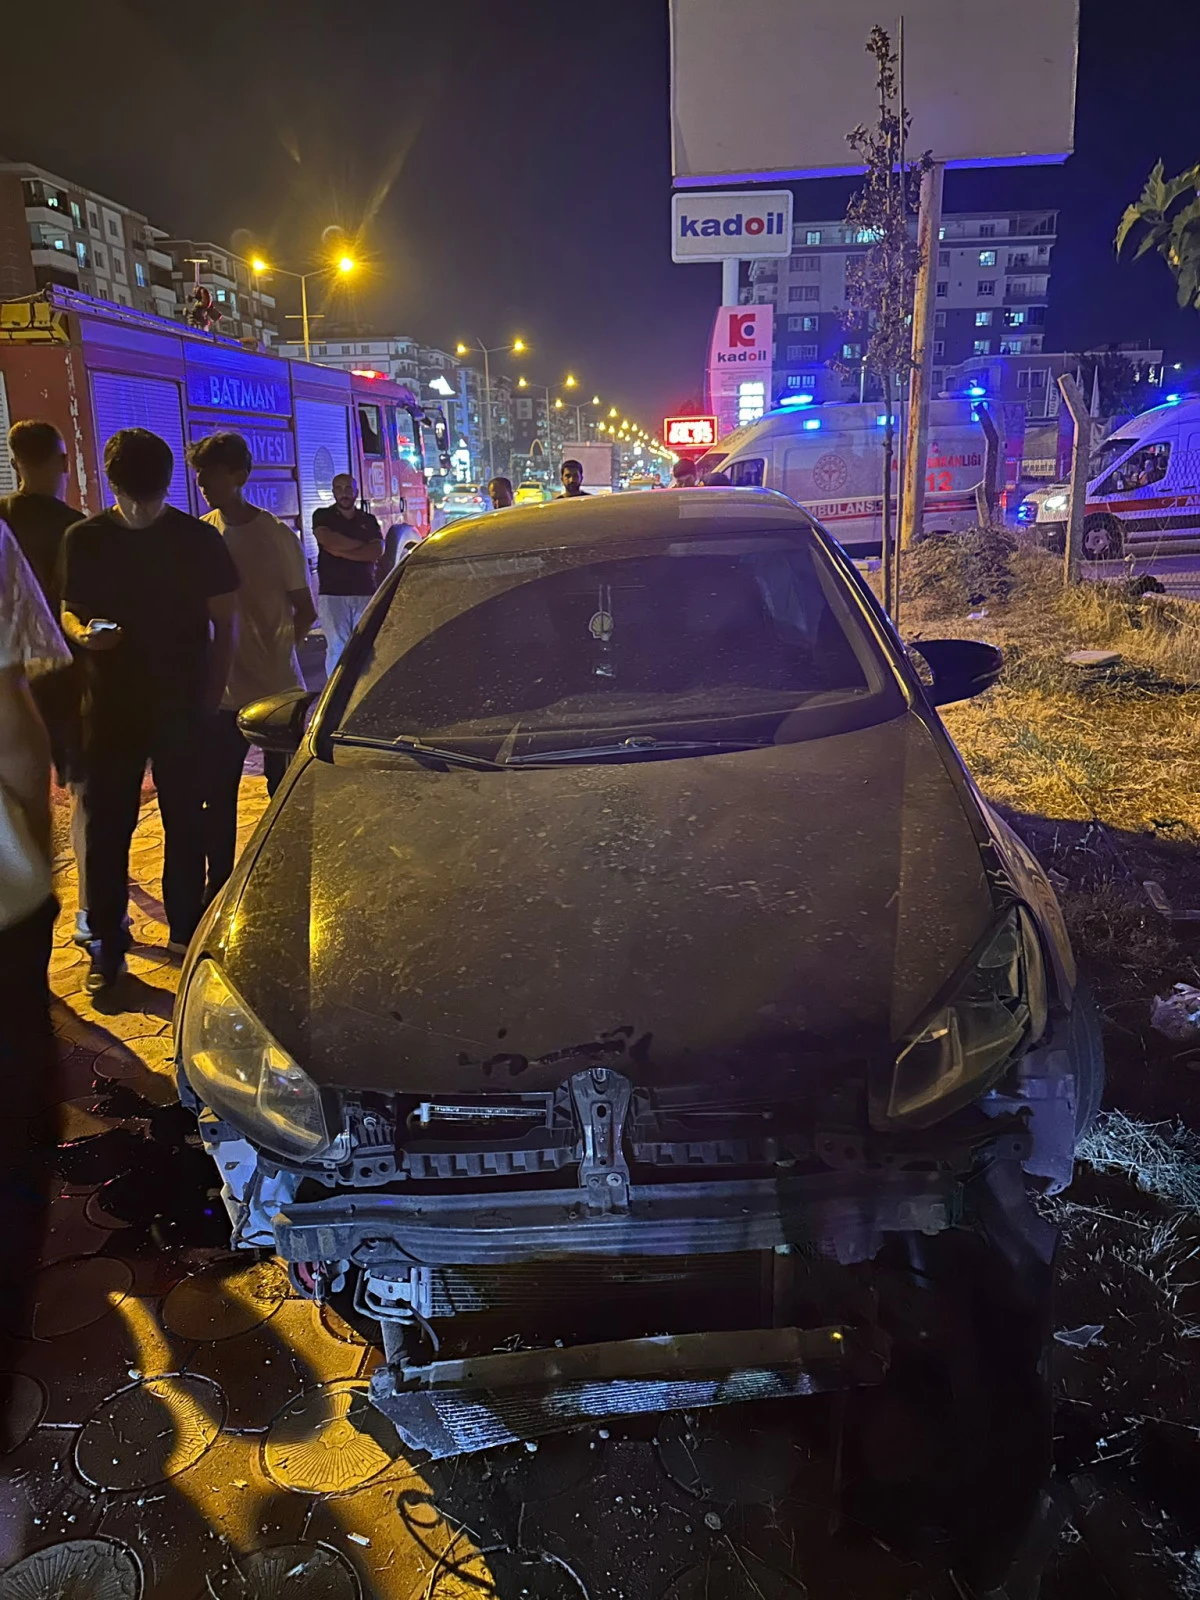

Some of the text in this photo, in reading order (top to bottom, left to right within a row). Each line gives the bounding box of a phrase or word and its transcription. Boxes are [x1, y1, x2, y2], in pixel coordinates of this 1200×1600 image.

[680, 212, 783, 237] kadoil
[717, 350, 767, 362] kadoil
[209, 375, 276, 410] BATMAN
[927, 452, 982, 469] BAKANLIĞI
[925, 470, 953, 493] 12
[808, 500, 874, 516] MBULANS
